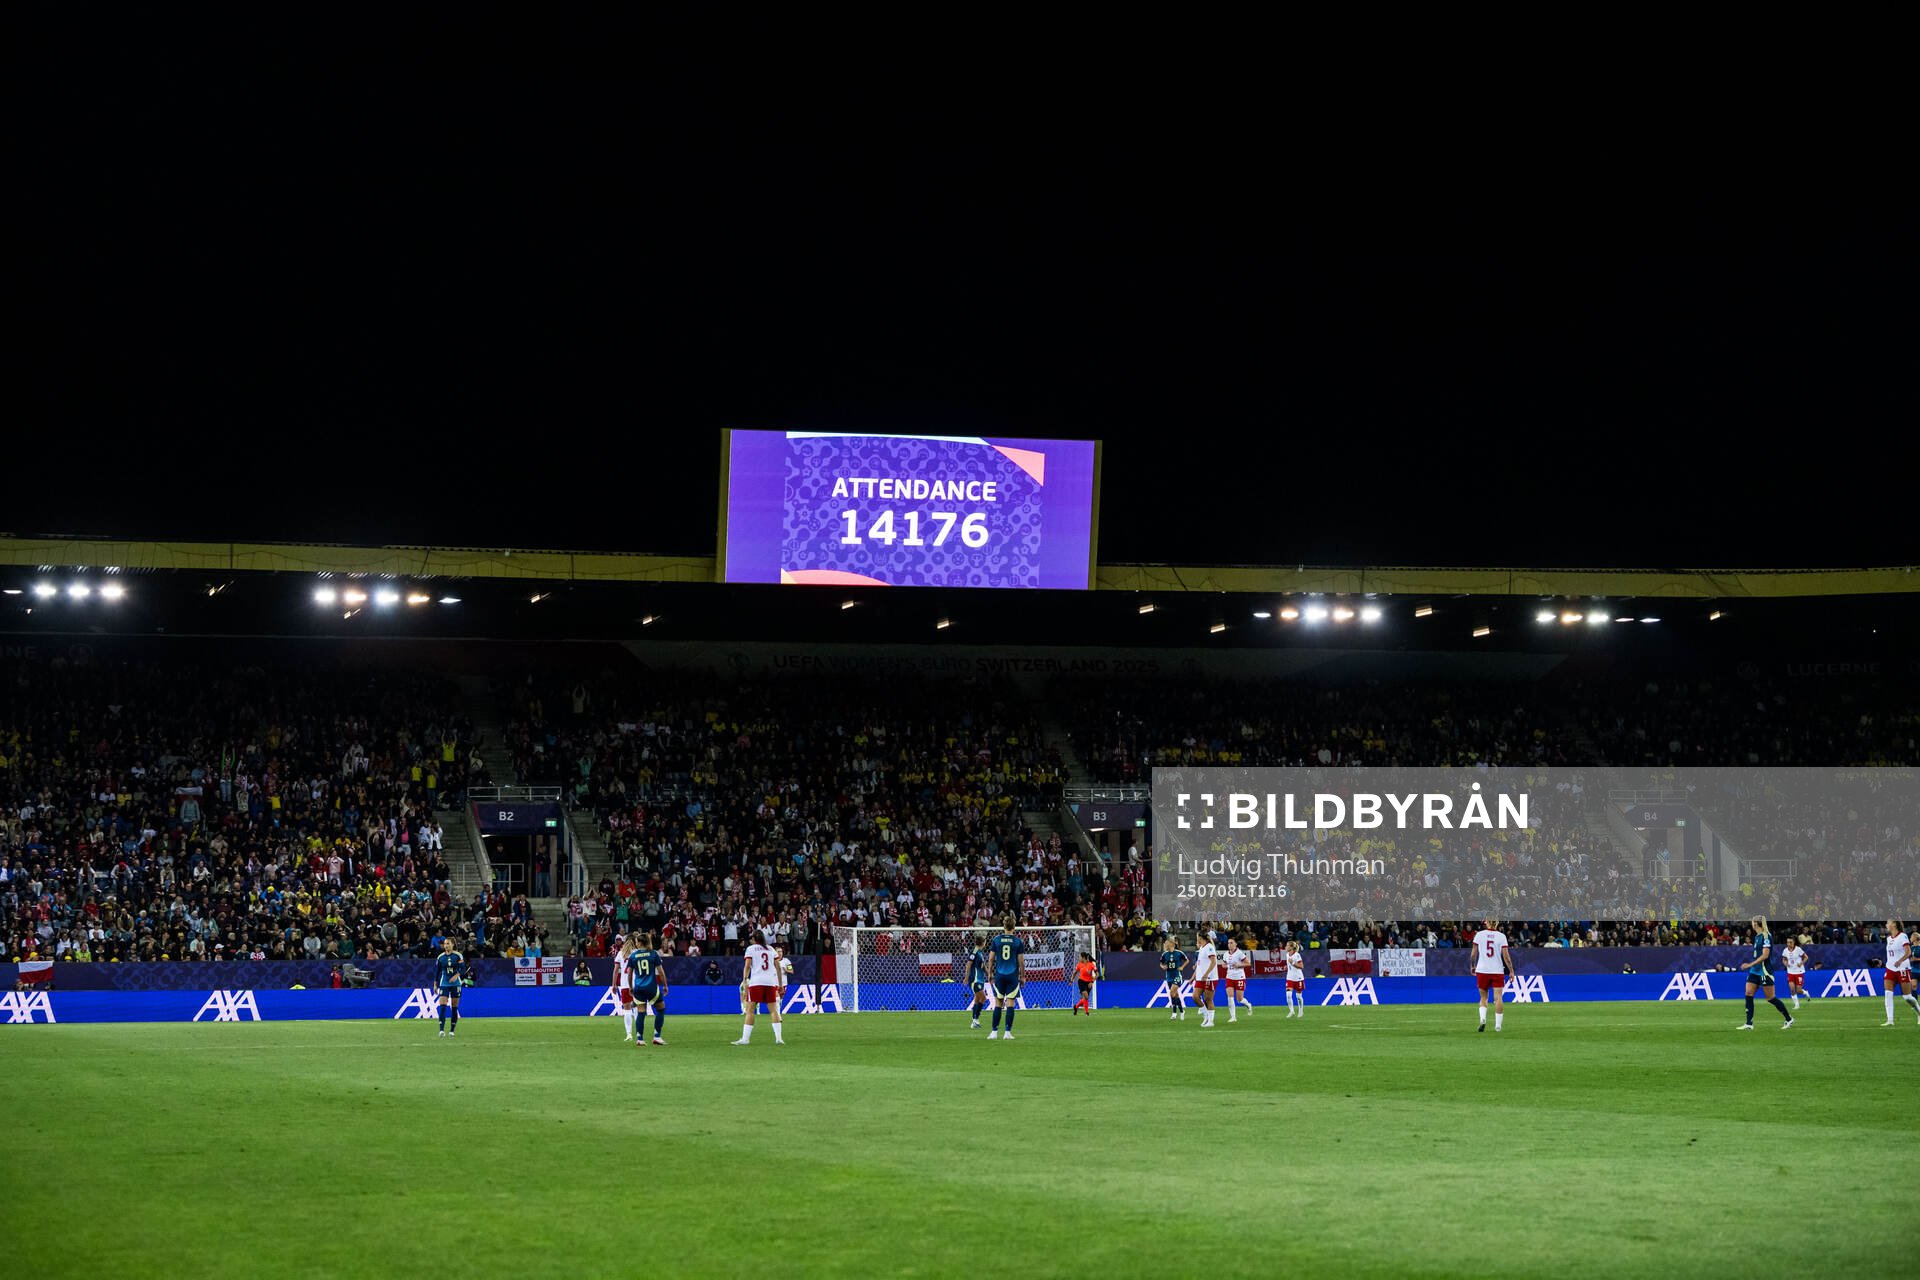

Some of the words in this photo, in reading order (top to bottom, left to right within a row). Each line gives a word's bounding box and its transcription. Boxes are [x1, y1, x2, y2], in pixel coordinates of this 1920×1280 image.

[831, 477, 997, 501] ATTENDANCE
[841, 510, 989, 548] 14176
[773, 655, 825, 670] UEFA
[921, 657, 972, 673] EURO
[976, 658, 1107, 674] SWITZERLAND
[1112, 659, 1161, 674] 2025
[499, 811, 514, 821] B2
[1093, 811, 1107, 821] B3
[1644, 812, 1657, 821] B4
[1002, 944, 1011, 960] 8
[1486, 940, 1494, 958] 5
[637, 959, 650, 976] 19
[761, 952, 770, 971] 3
[1321, 977, 1379, 1006] AXA
[1502, 975, 1550, 1003] AXA
[1659, 972, 1715, 1001] AXA
[1821, 969, 1877, 998] AXA
[0, 991, 56, 1023] AXA
[192, 990, 262, 1021] AXA
